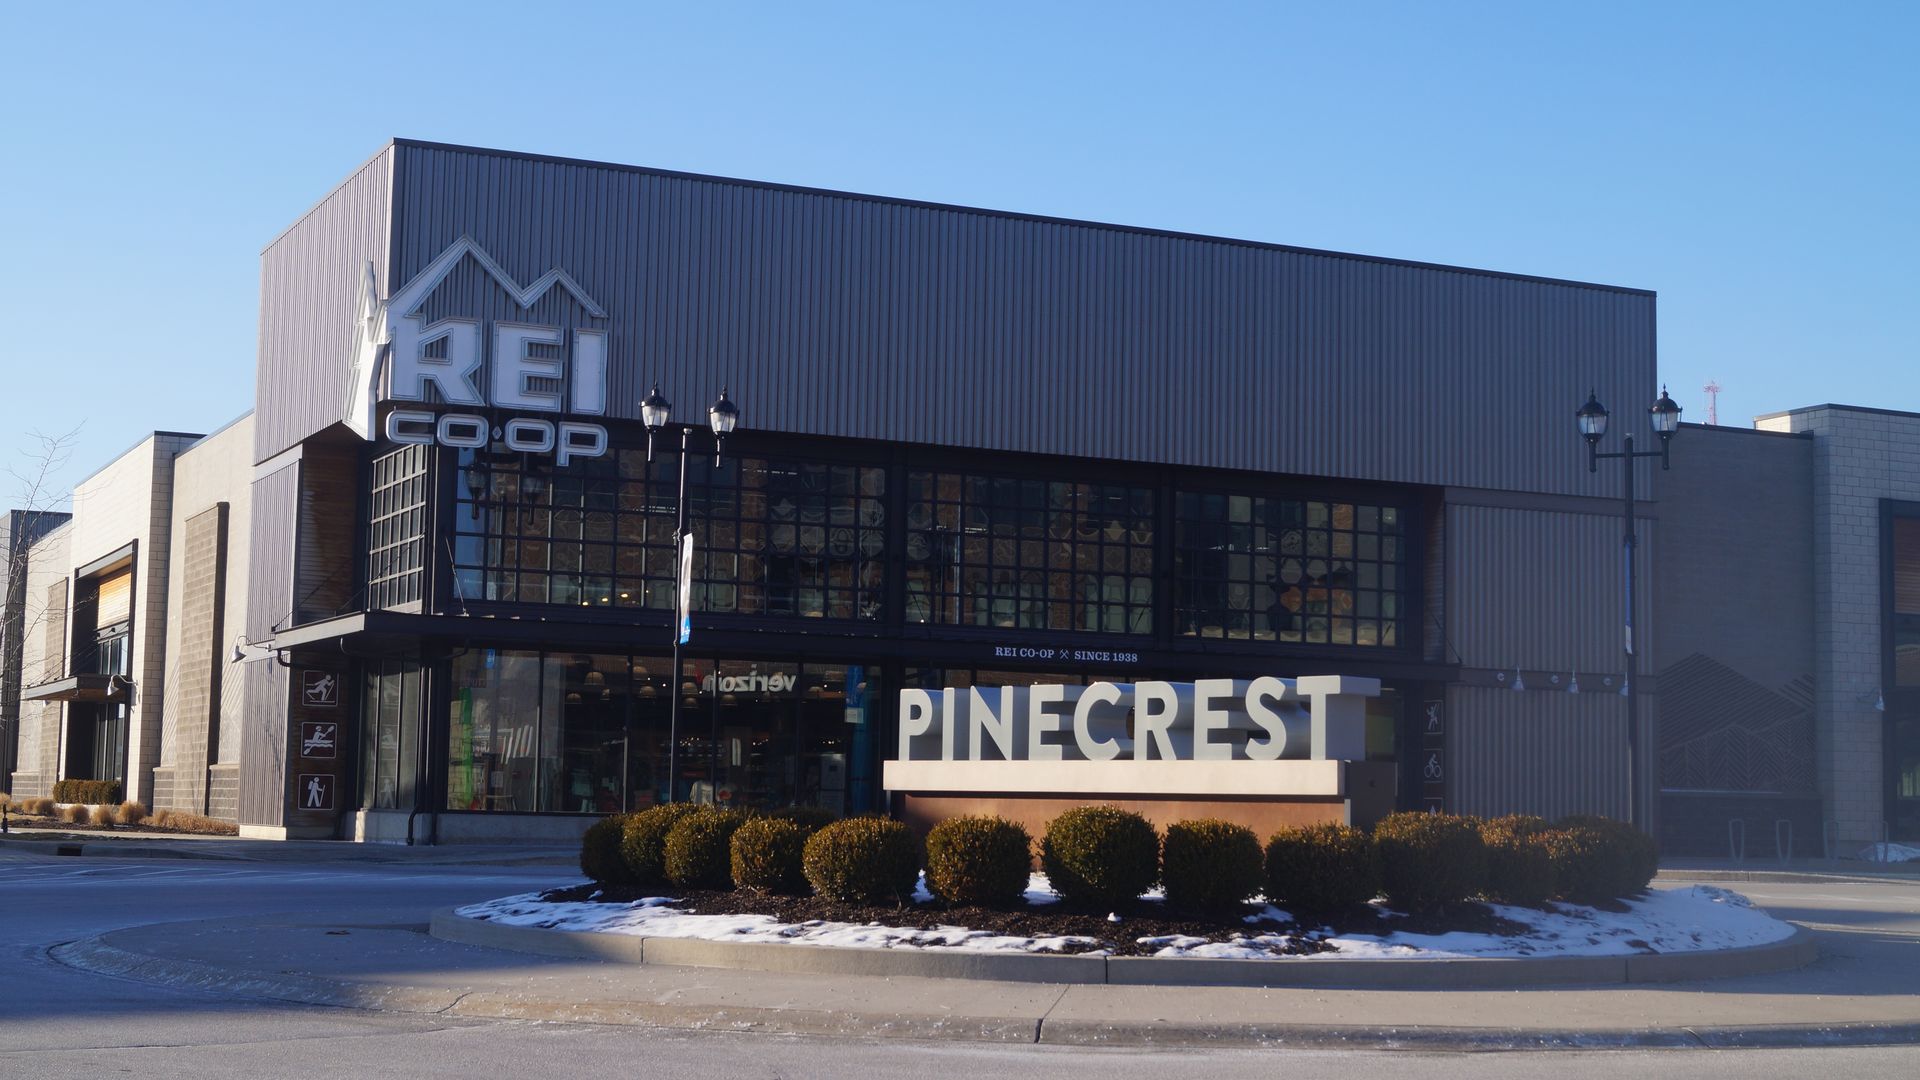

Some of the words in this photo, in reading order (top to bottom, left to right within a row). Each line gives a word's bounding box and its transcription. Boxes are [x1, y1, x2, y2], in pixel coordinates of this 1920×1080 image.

[393, 314, 608, 415] REI
[995, 647, 1016, 657] REI
[1020, 648, 1055, 659] CO-OP
[1074, 650, 1110, 661] SINCE
[1112, 652, 1138, 662] 1938
[899, 676, 1341, 761] PINECREST
